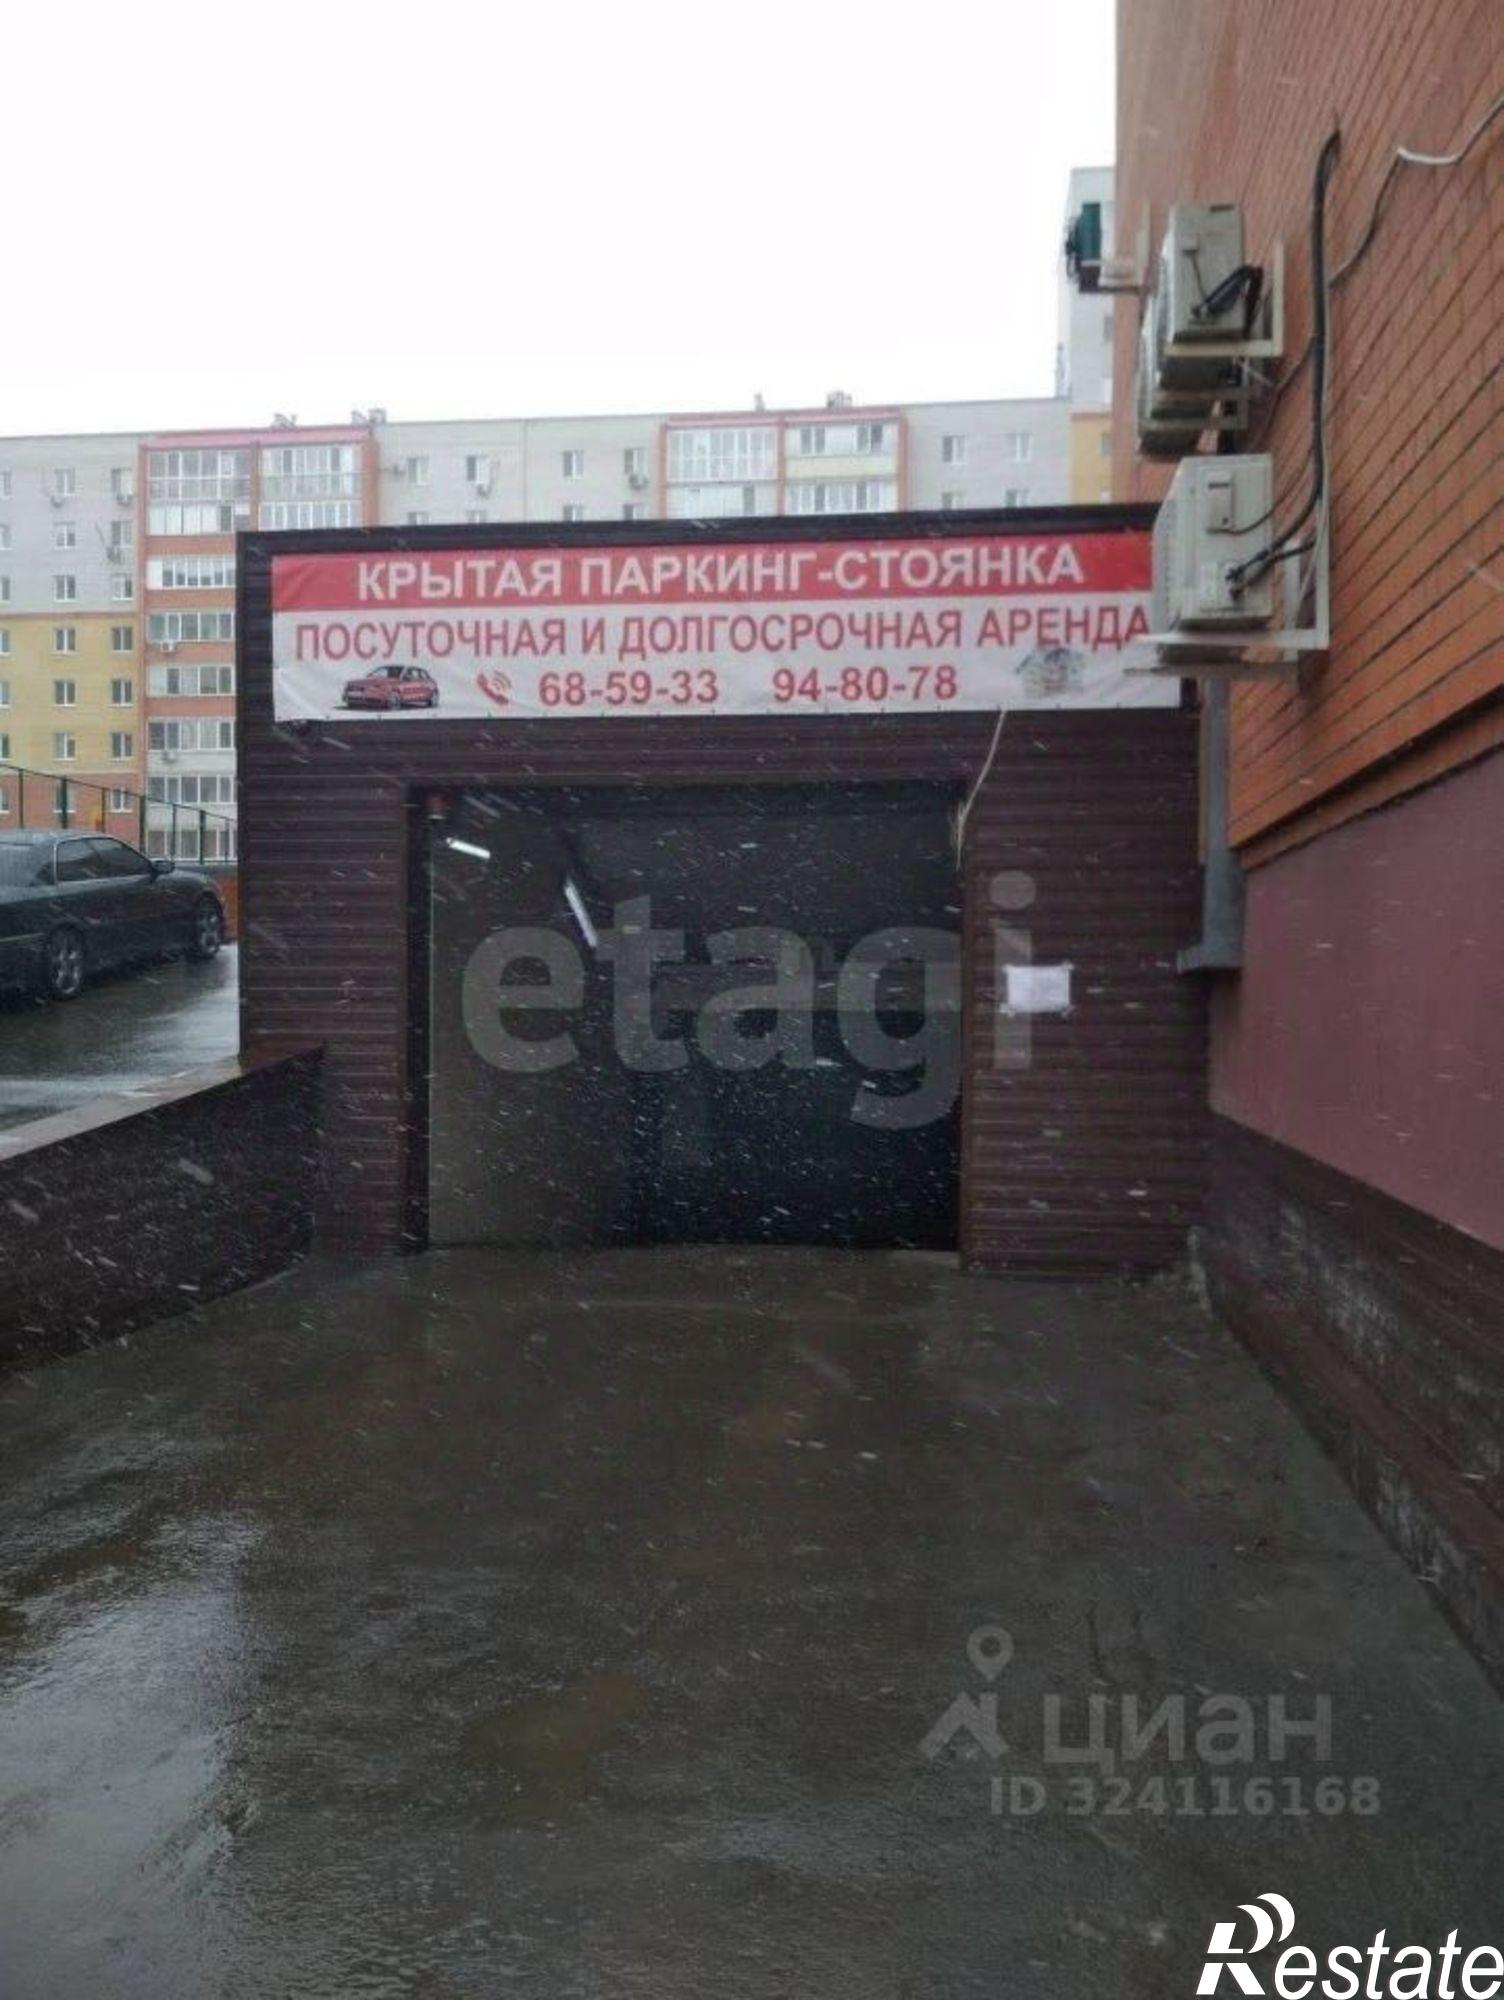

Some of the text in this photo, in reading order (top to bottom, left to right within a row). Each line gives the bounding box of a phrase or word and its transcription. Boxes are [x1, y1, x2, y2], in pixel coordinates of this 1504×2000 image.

[358, 543, 1085, 600] КРЫТАЯ ПАРКИНГ-СТОЯНКА
[296, 604, 1150, 661] ПОСУТОЧНАЯ И ДОЛГОСРОЧНАЯ АРЕНДА
[538, 665, 958, 707] 68-59-33 94-80-78
